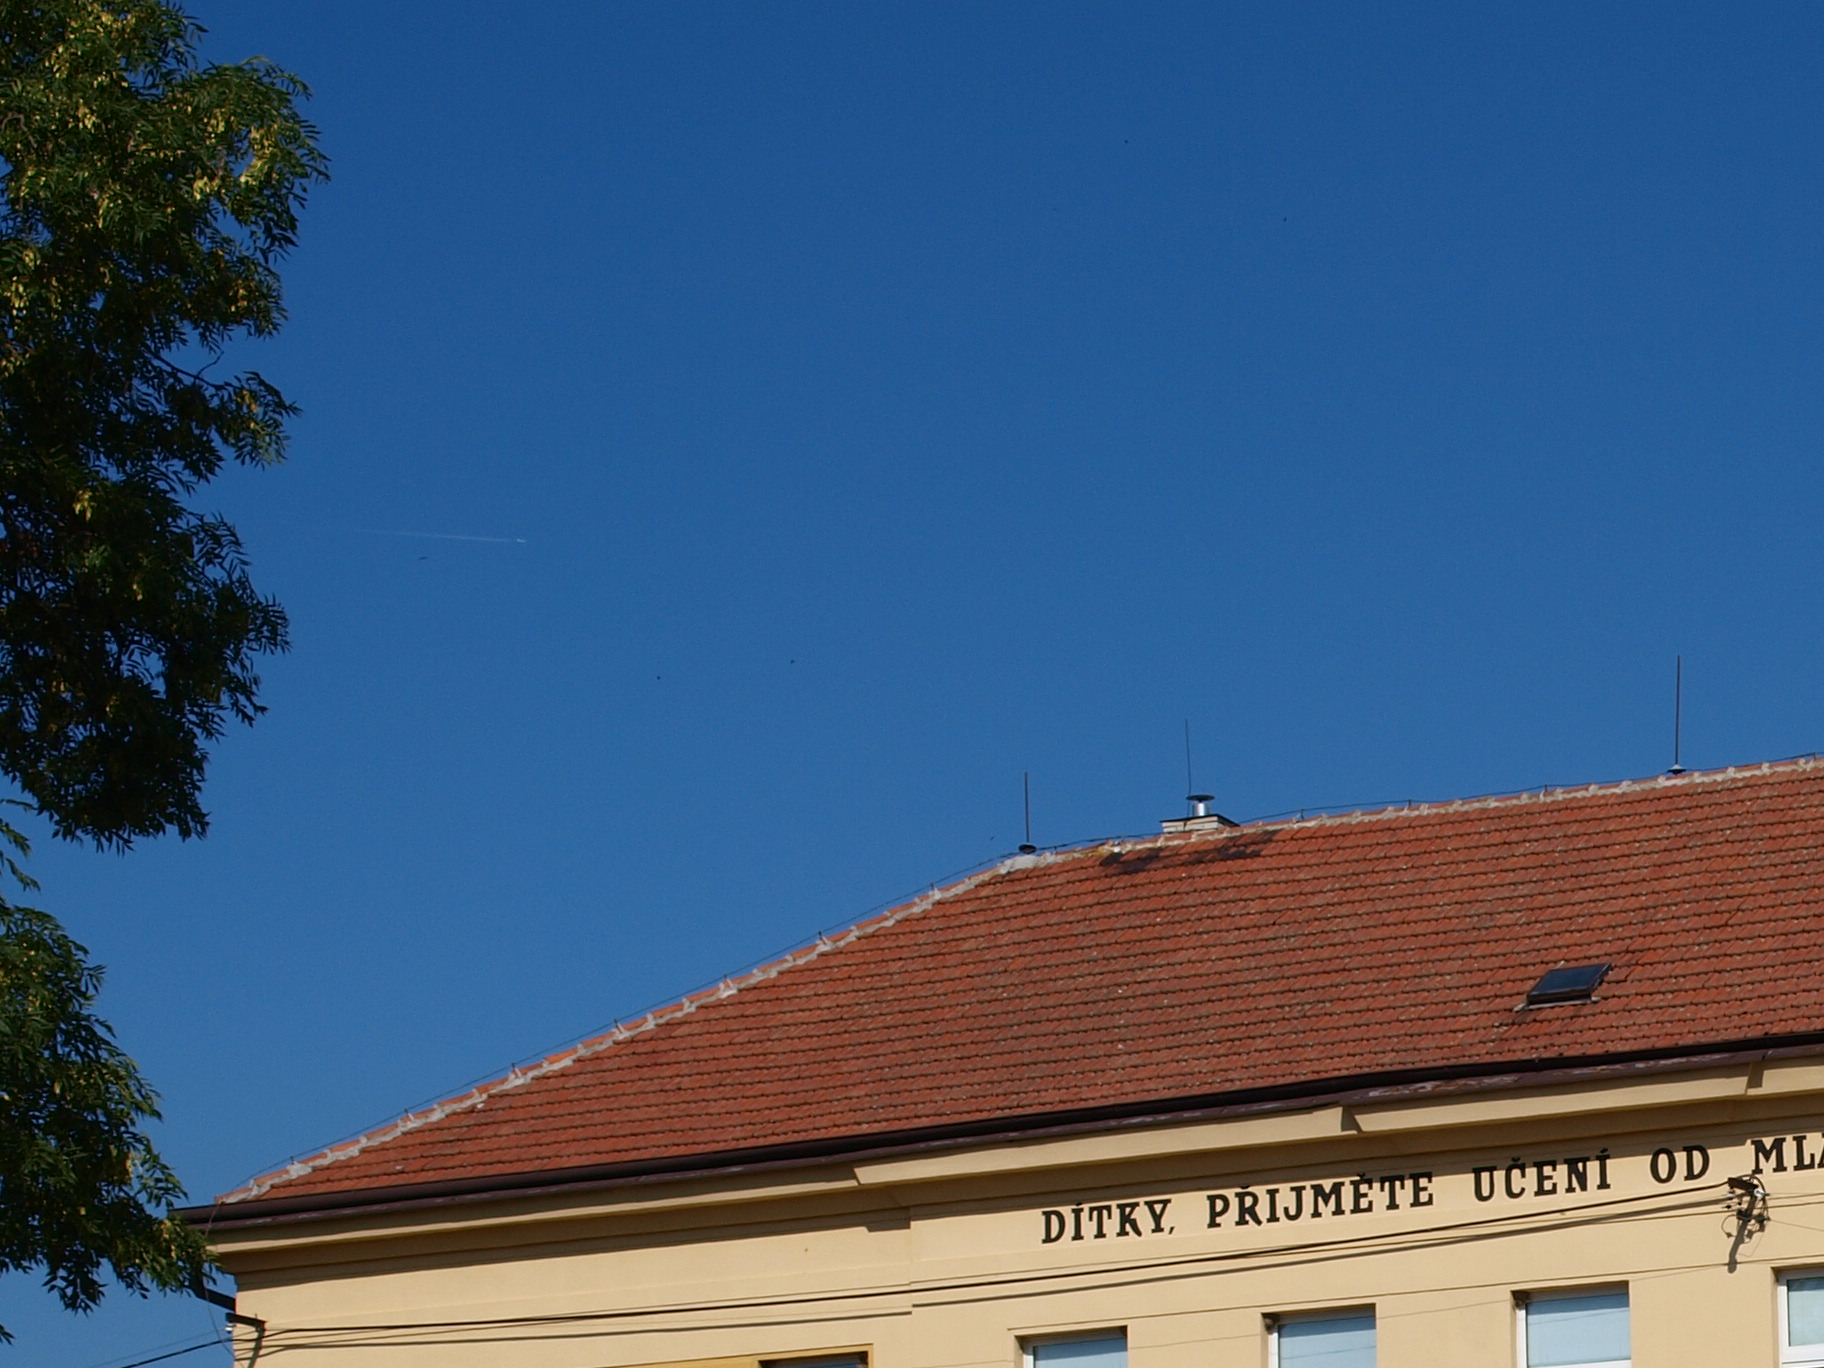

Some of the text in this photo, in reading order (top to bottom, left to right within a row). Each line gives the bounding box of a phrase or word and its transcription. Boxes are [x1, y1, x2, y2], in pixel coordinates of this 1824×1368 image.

[1041, 1198, 1175, 1245] DÍTKY,
[1206, 1172, 1434, 1227] PŘIJMĚTE
[1472, 1148, 1611, 1202] UČENÍ
[1650, 1144, 1710, 1184] OD
